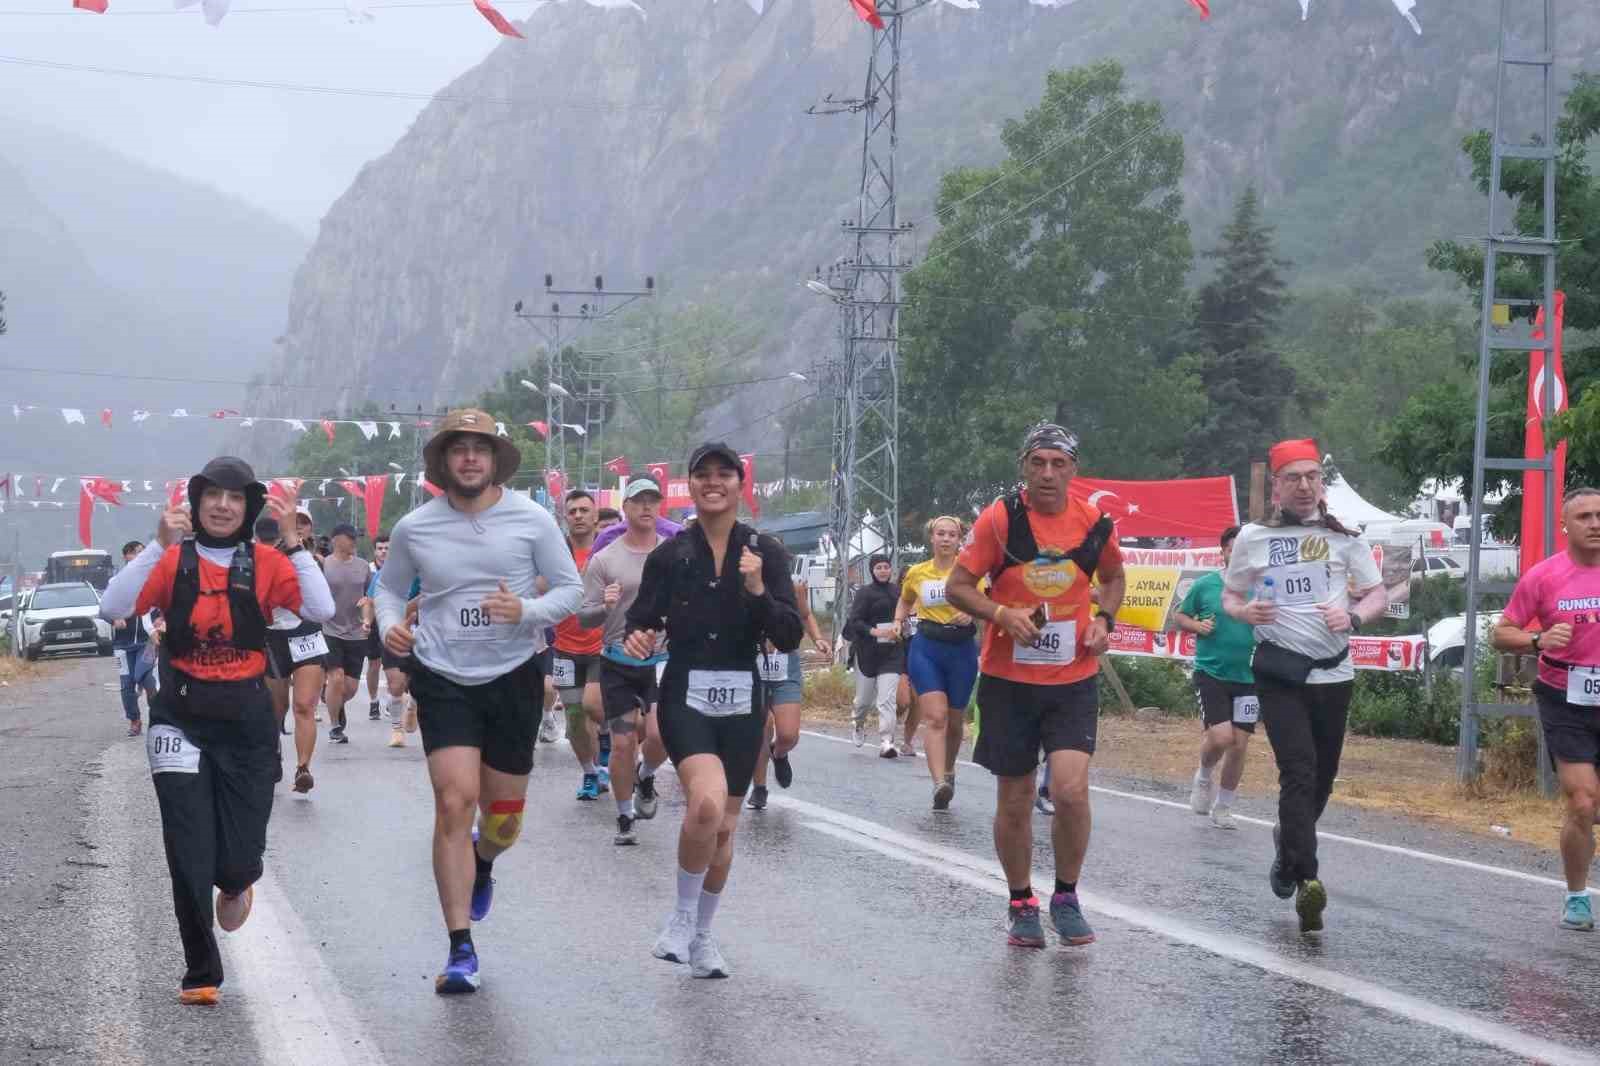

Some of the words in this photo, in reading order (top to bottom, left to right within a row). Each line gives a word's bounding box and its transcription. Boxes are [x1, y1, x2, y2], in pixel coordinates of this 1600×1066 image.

[1135, 580, 1171, 592] AYRAN
[1286, 576, 1312, 595] 013
[1557, 597, 1600, 612] RUNKE
[706, 686, 737, 705] 031
[154, 735, 182, 754] 018
